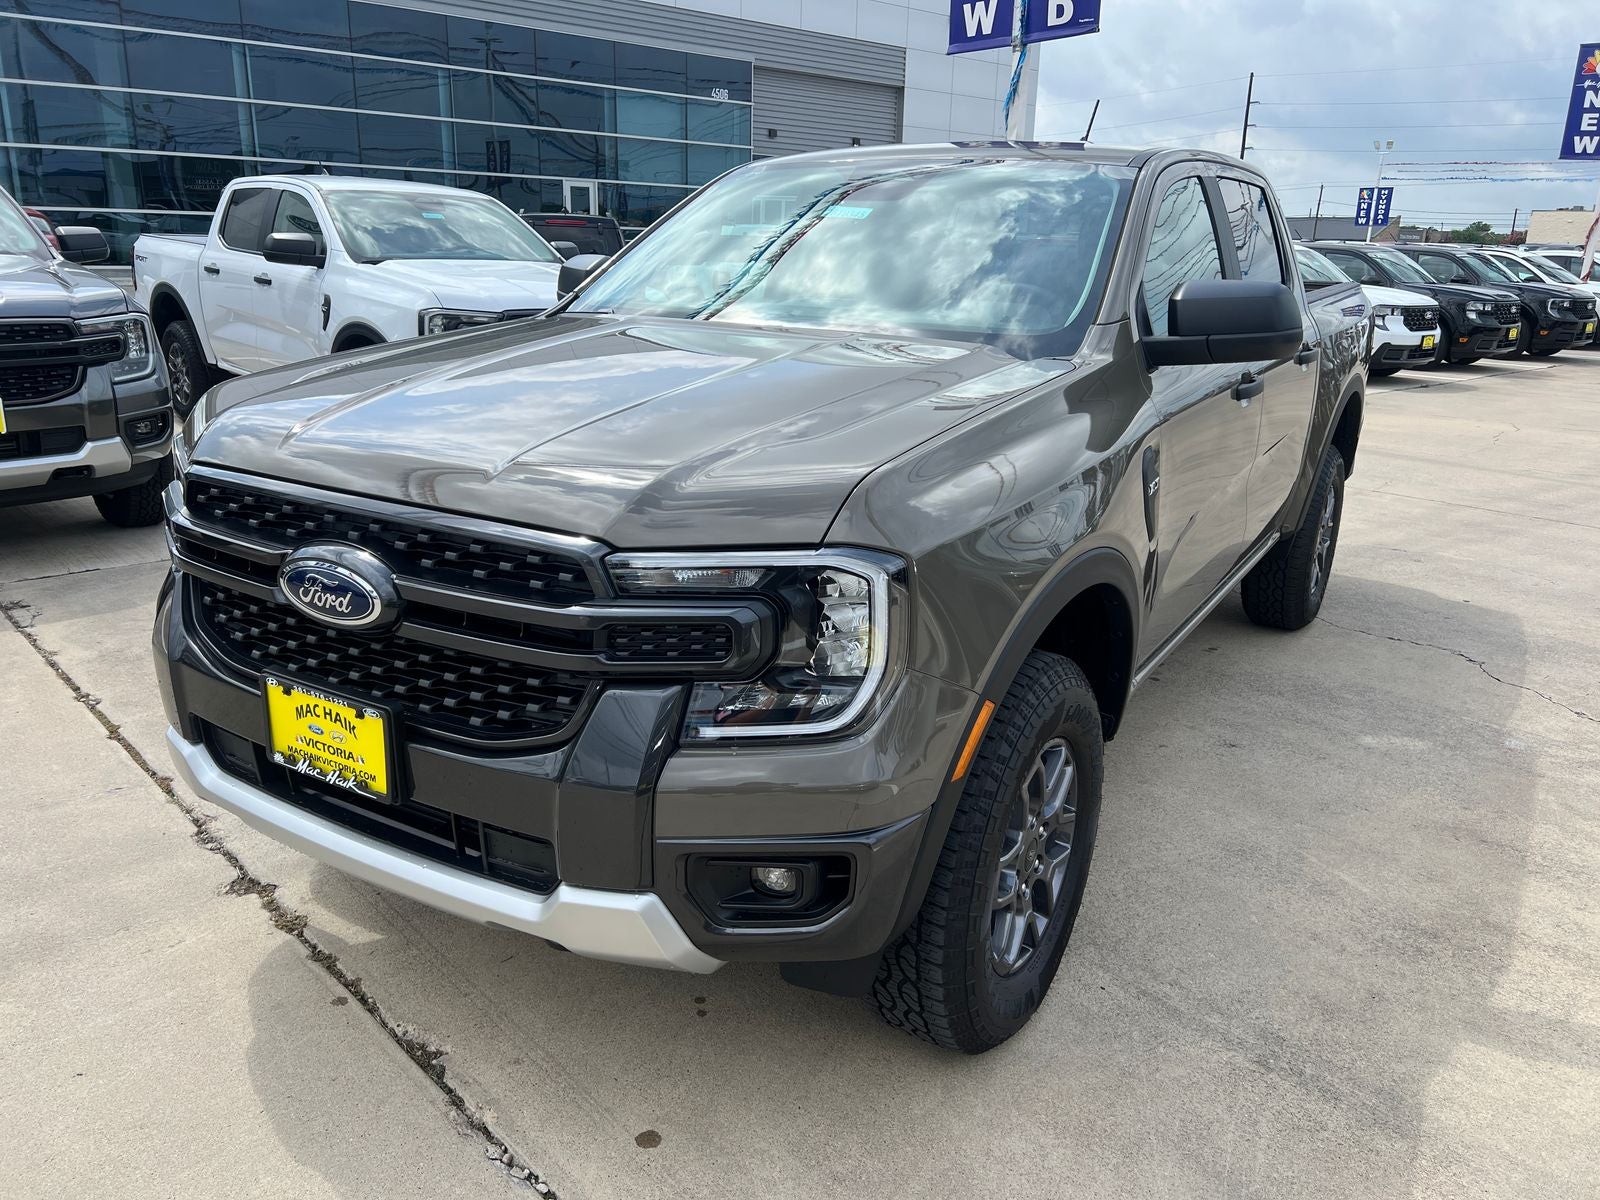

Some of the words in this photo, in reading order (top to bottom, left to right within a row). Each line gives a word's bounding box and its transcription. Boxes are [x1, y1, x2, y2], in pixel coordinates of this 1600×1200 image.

[711, 87, 729, 100] 4506
[1573, 90, 1600, 154] NEW
[1358, 202, 1368, 225] NEW
[1377, 189, 1389, 224] HYUNDAI
[299, 573, 352, 614] Ford
[295, 703, 320, 720] MAC
[323, 706, 358, 740] HAIK
[287, 745, 377, 783] MACHAIKVICTORIA.COM
[303, 735, 355, 763] VICTORIA
[295, 758, 325, 779] Mac
[325, 770, 360, 789] Haik
